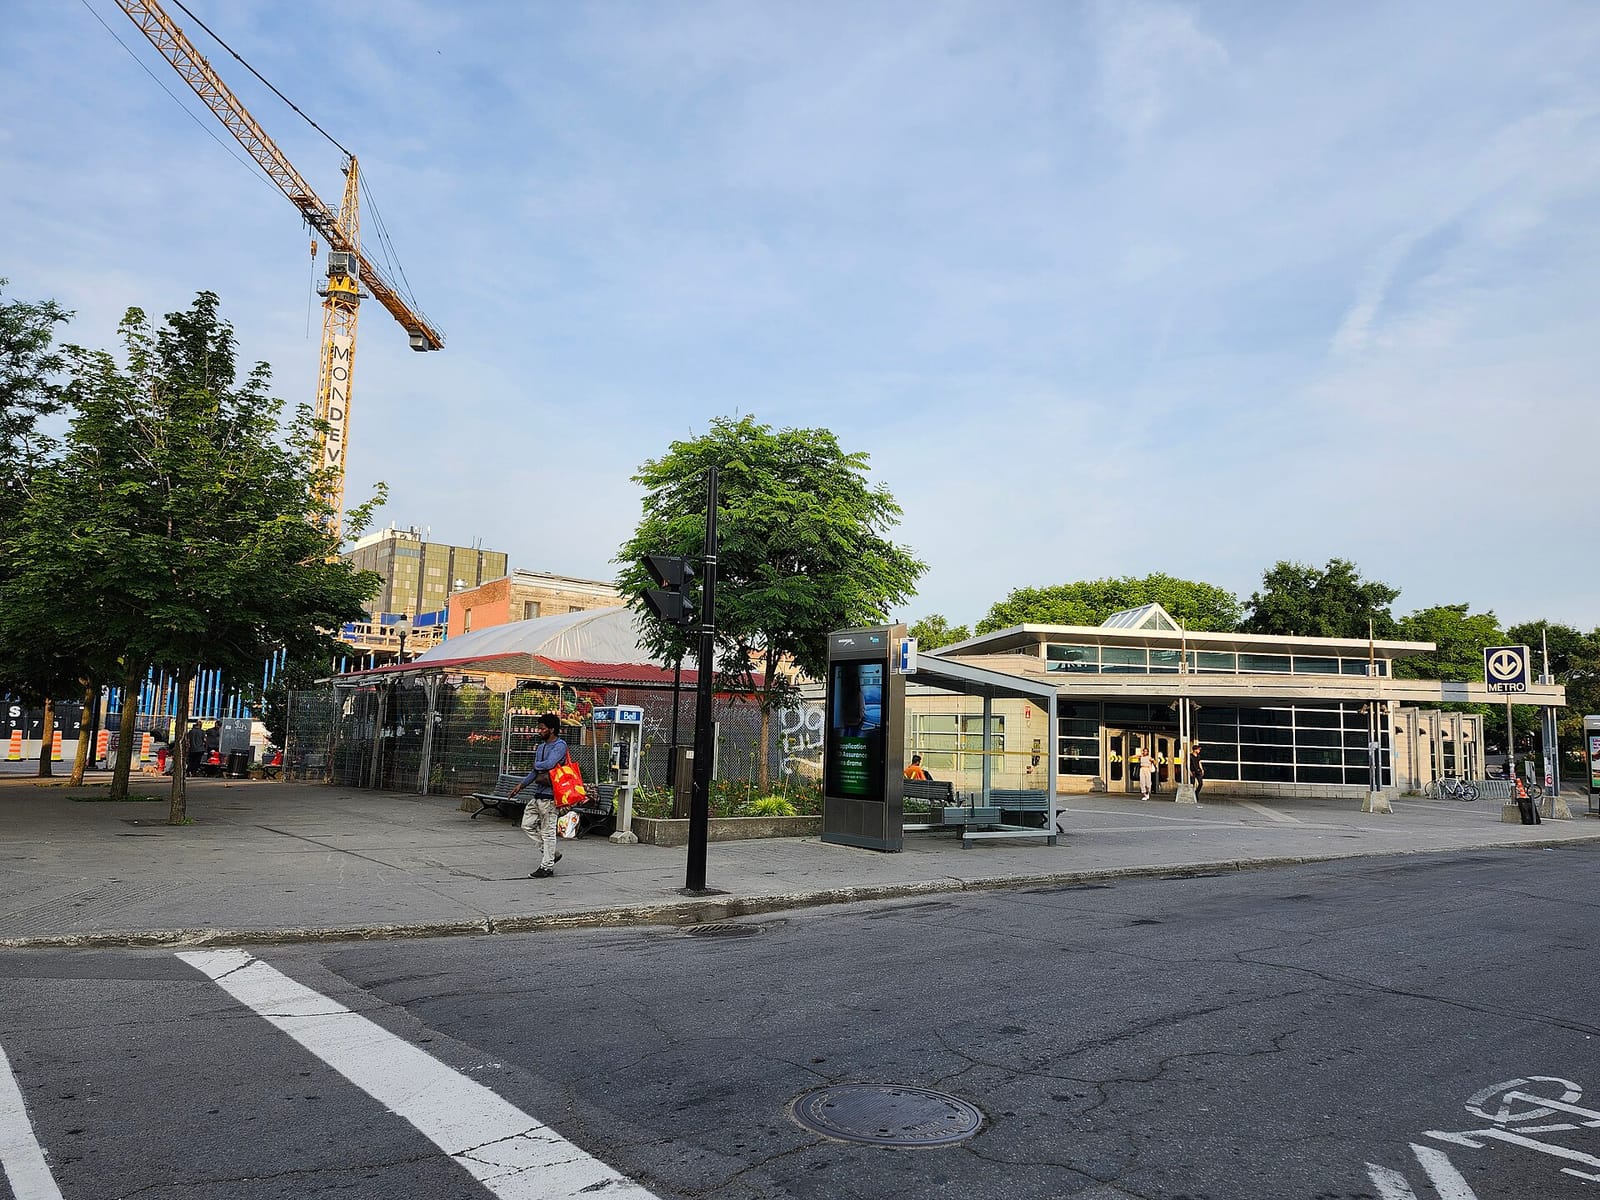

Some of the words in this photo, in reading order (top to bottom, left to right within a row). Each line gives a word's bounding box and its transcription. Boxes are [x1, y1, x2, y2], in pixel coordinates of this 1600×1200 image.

[327, 345, 349, 462] MONDEV
[1488, 682, 1524, 691] METRO
[623, 711, 637, 720] Bell
